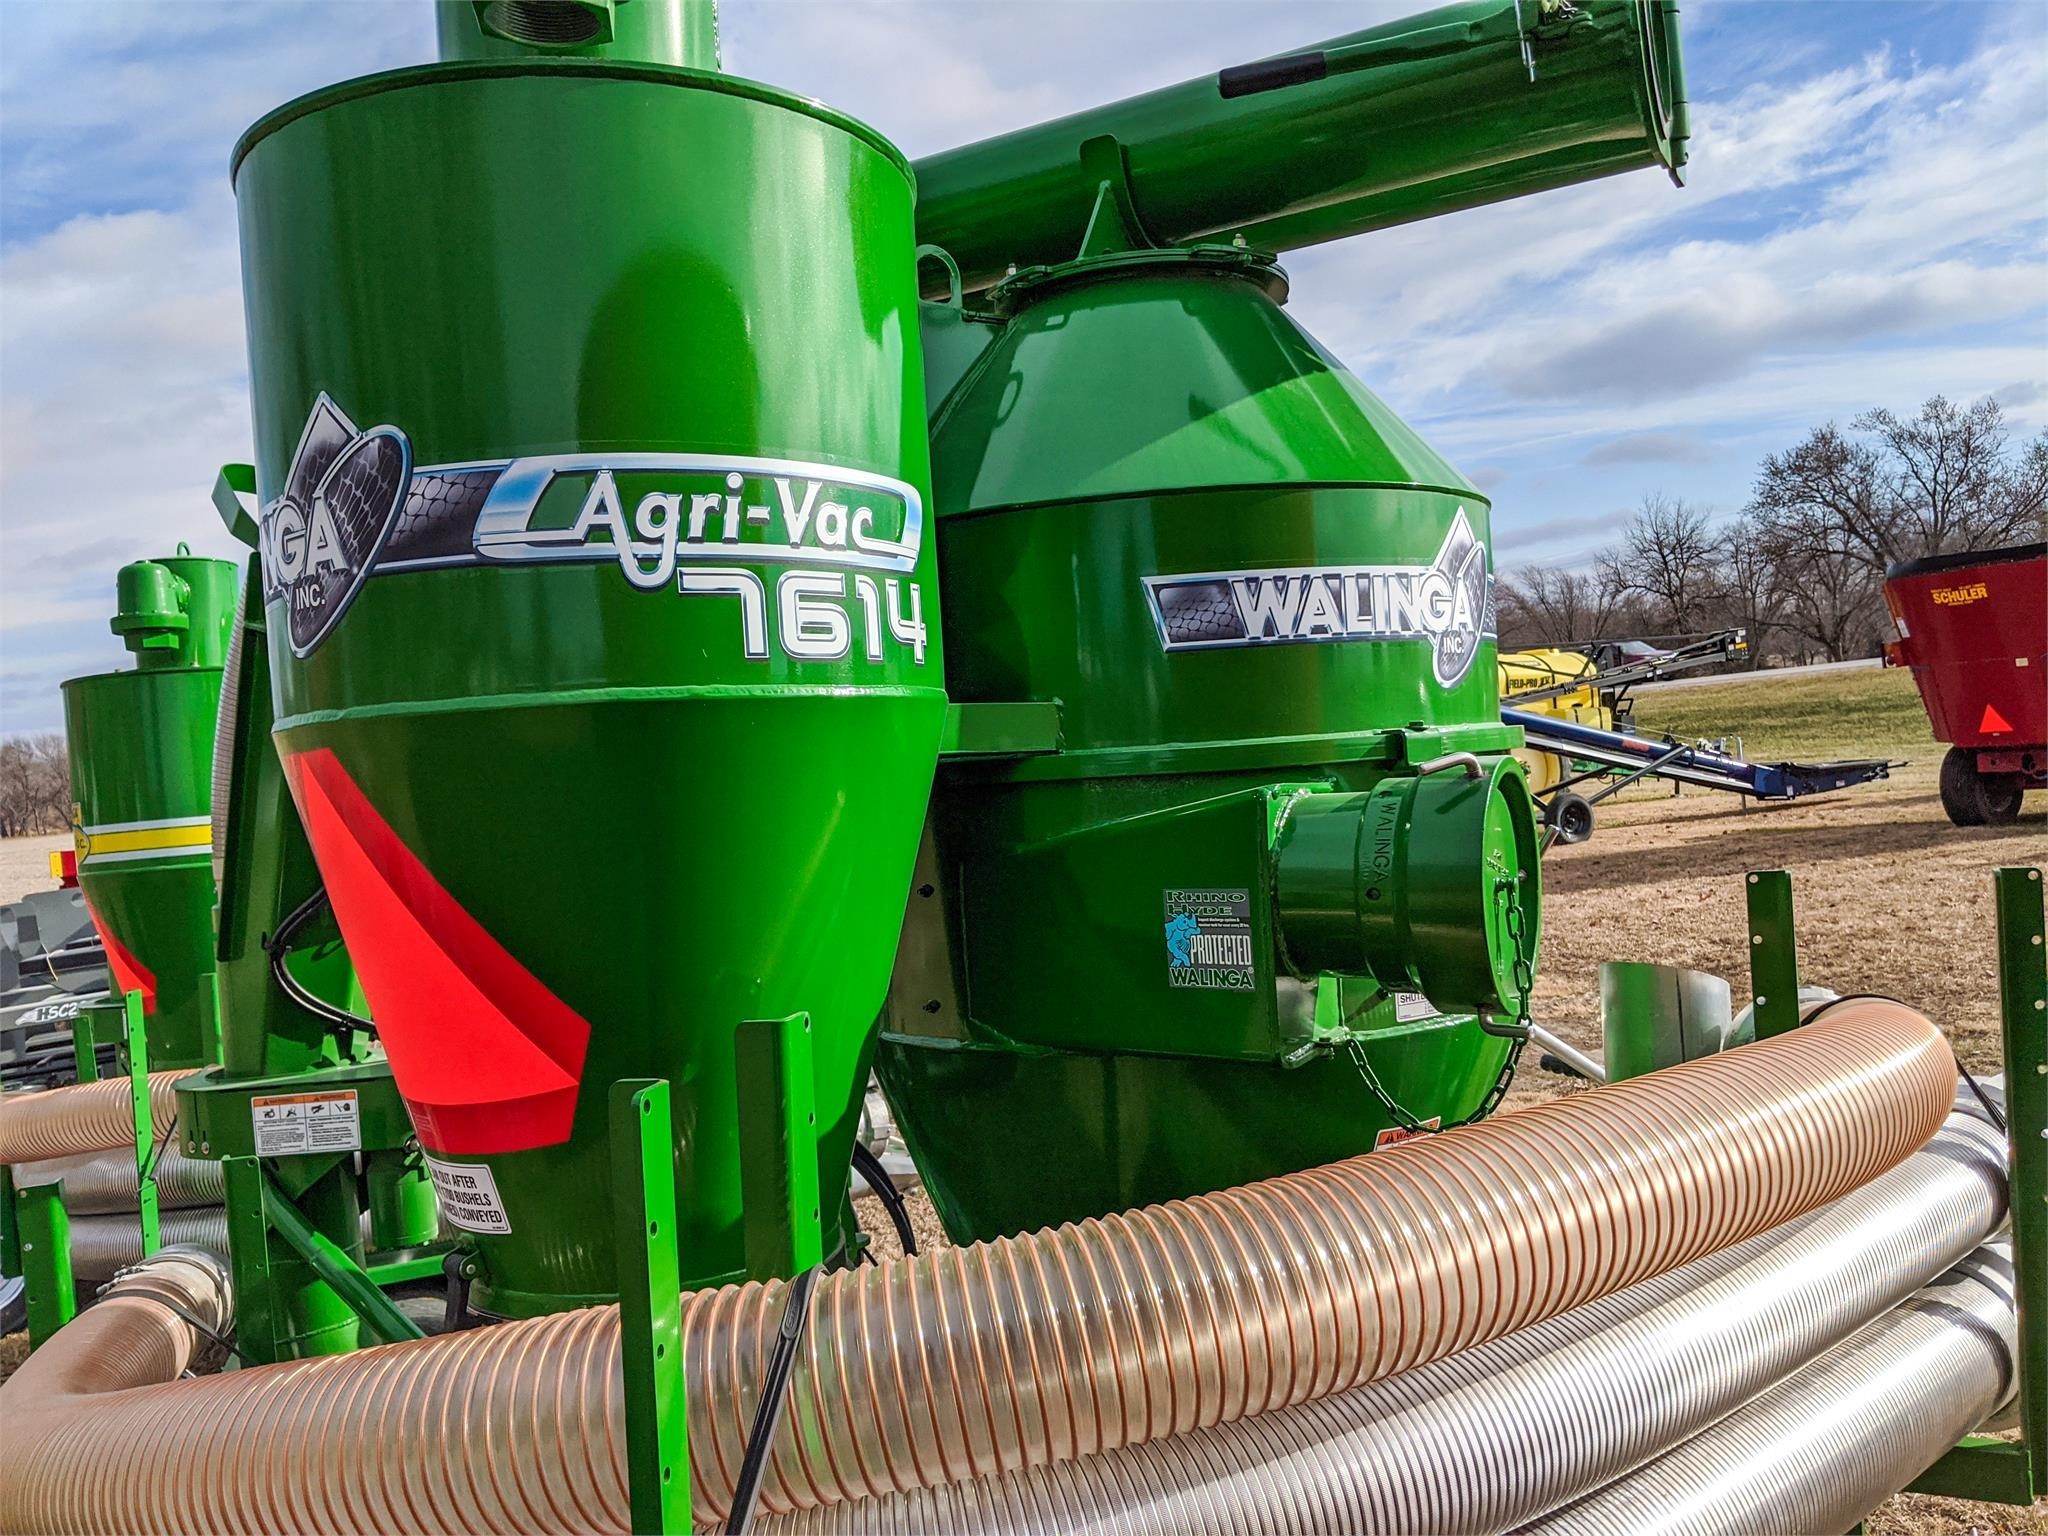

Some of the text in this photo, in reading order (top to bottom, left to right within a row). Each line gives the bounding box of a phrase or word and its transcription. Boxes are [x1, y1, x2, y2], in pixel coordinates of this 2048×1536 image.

[571, 467, 880, 588] Agri-Vac
[295, 584, 326, 610] INC.
[1231, 571, 1475, 640] WALINGA
[1933, 587, 1988, 604] SCHULER
[677, 566, 927, 665] 7614
[1443, 636, 1465, 655] INC.
[1372, 802, 1397, 884] WALINGA
[1190, 934, 1252, 965] PROTECTED
[1169, 967, 1255, 989] WALINGA
[35, 1002, 78, 1021] HSC2
[451, 1174, 477, 1190] AFTER
[454, 1190, 492, 1207] BUSHELS
[459, 1206, 503, 1223] CONVEYED
